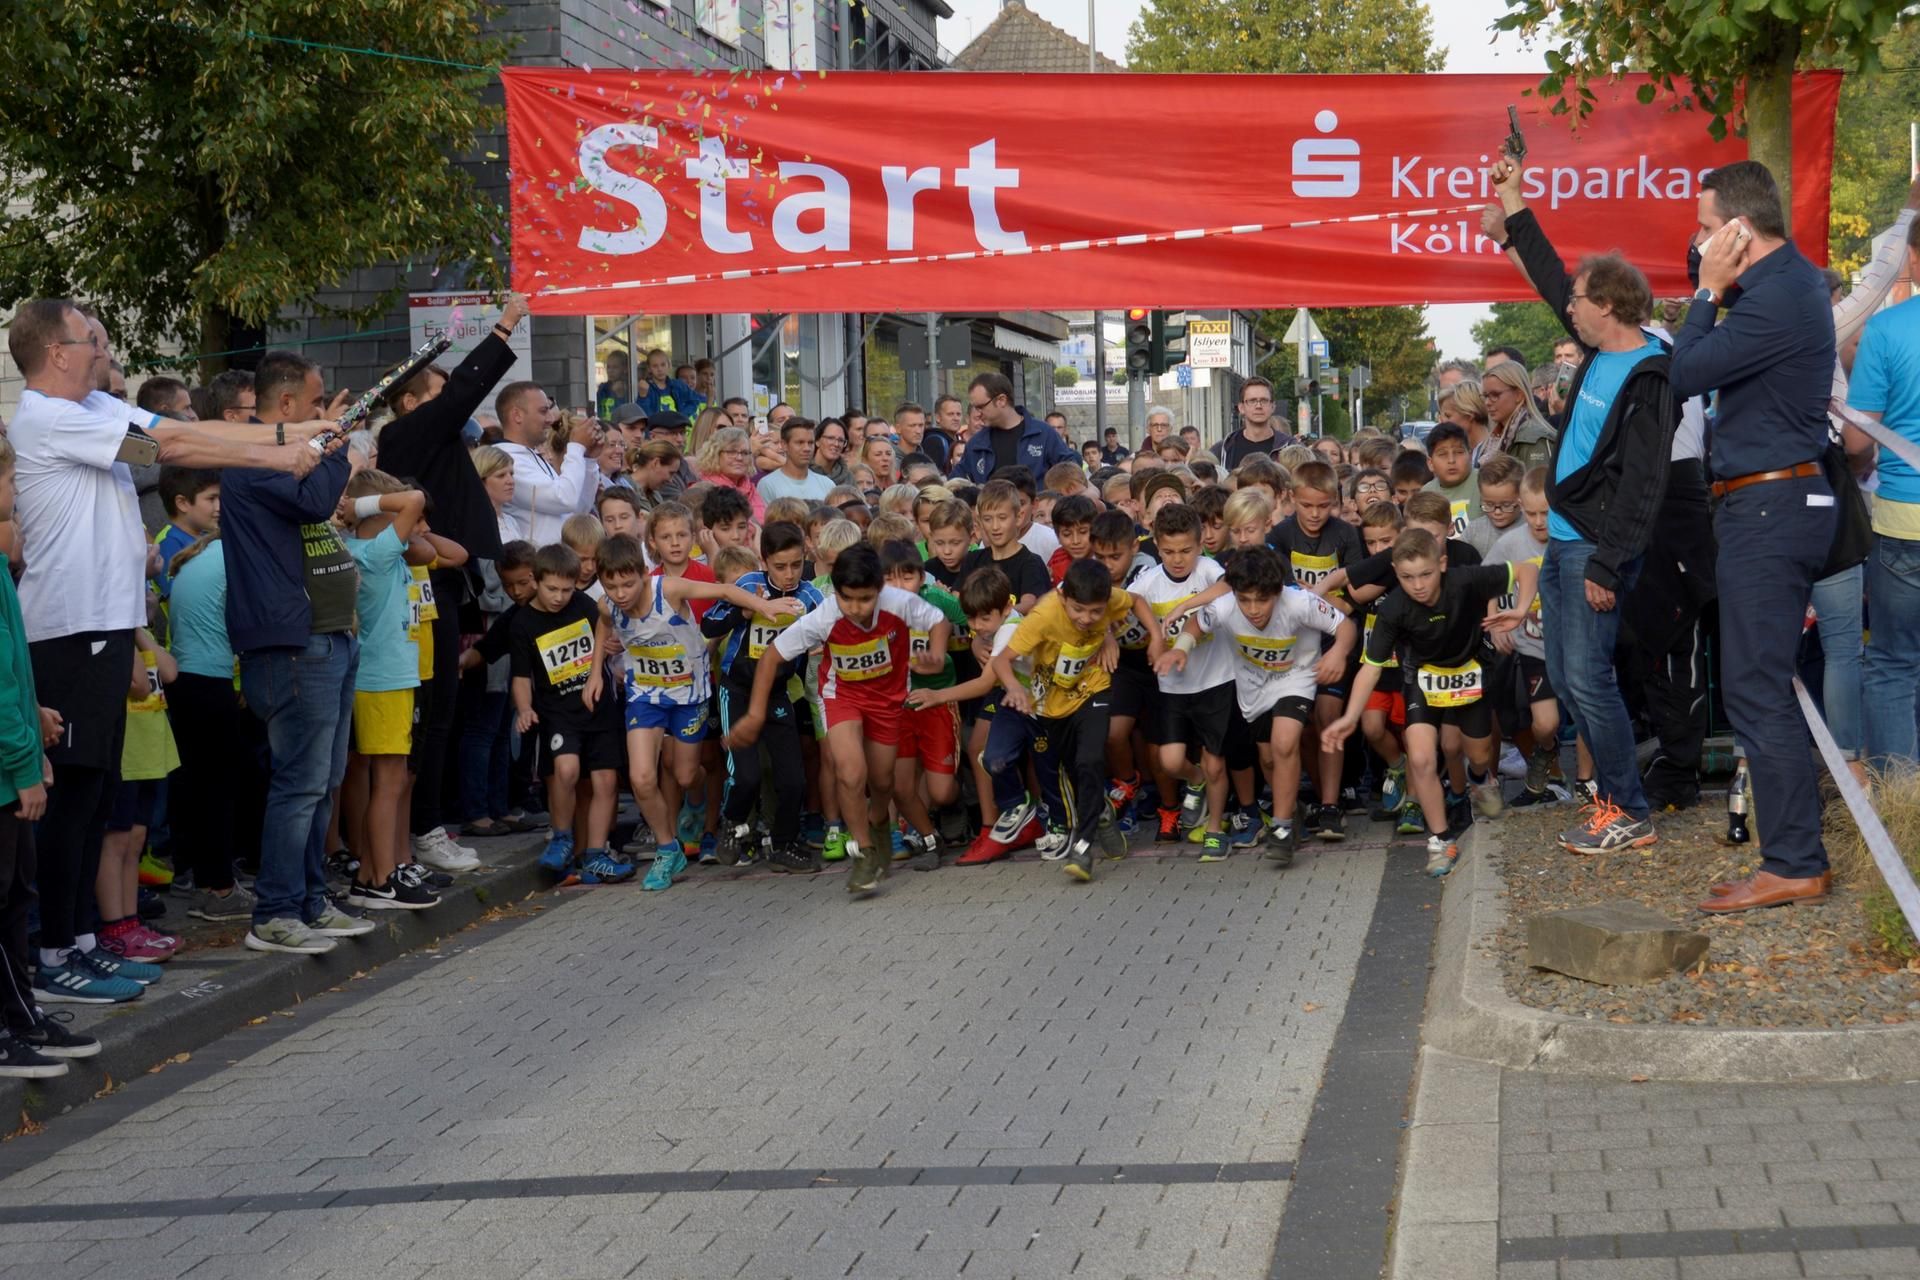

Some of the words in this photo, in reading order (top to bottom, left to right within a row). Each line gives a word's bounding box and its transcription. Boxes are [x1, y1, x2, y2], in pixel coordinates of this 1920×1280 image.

[577, 122, 1029, 254] Start
[1392, 153, 1715, 210] Kreisparka
[1194, 323, 1226, 333] TAXI
[305, 538, 338, 557] DARE
[546, 636, 592, 667] 1279
[833, 650, 887, 670] 1288
[1240, 645, 1290, 661] 1787
[636, 658, 685, 675] 1813
[1423, 671, 1477, 691] 1083
